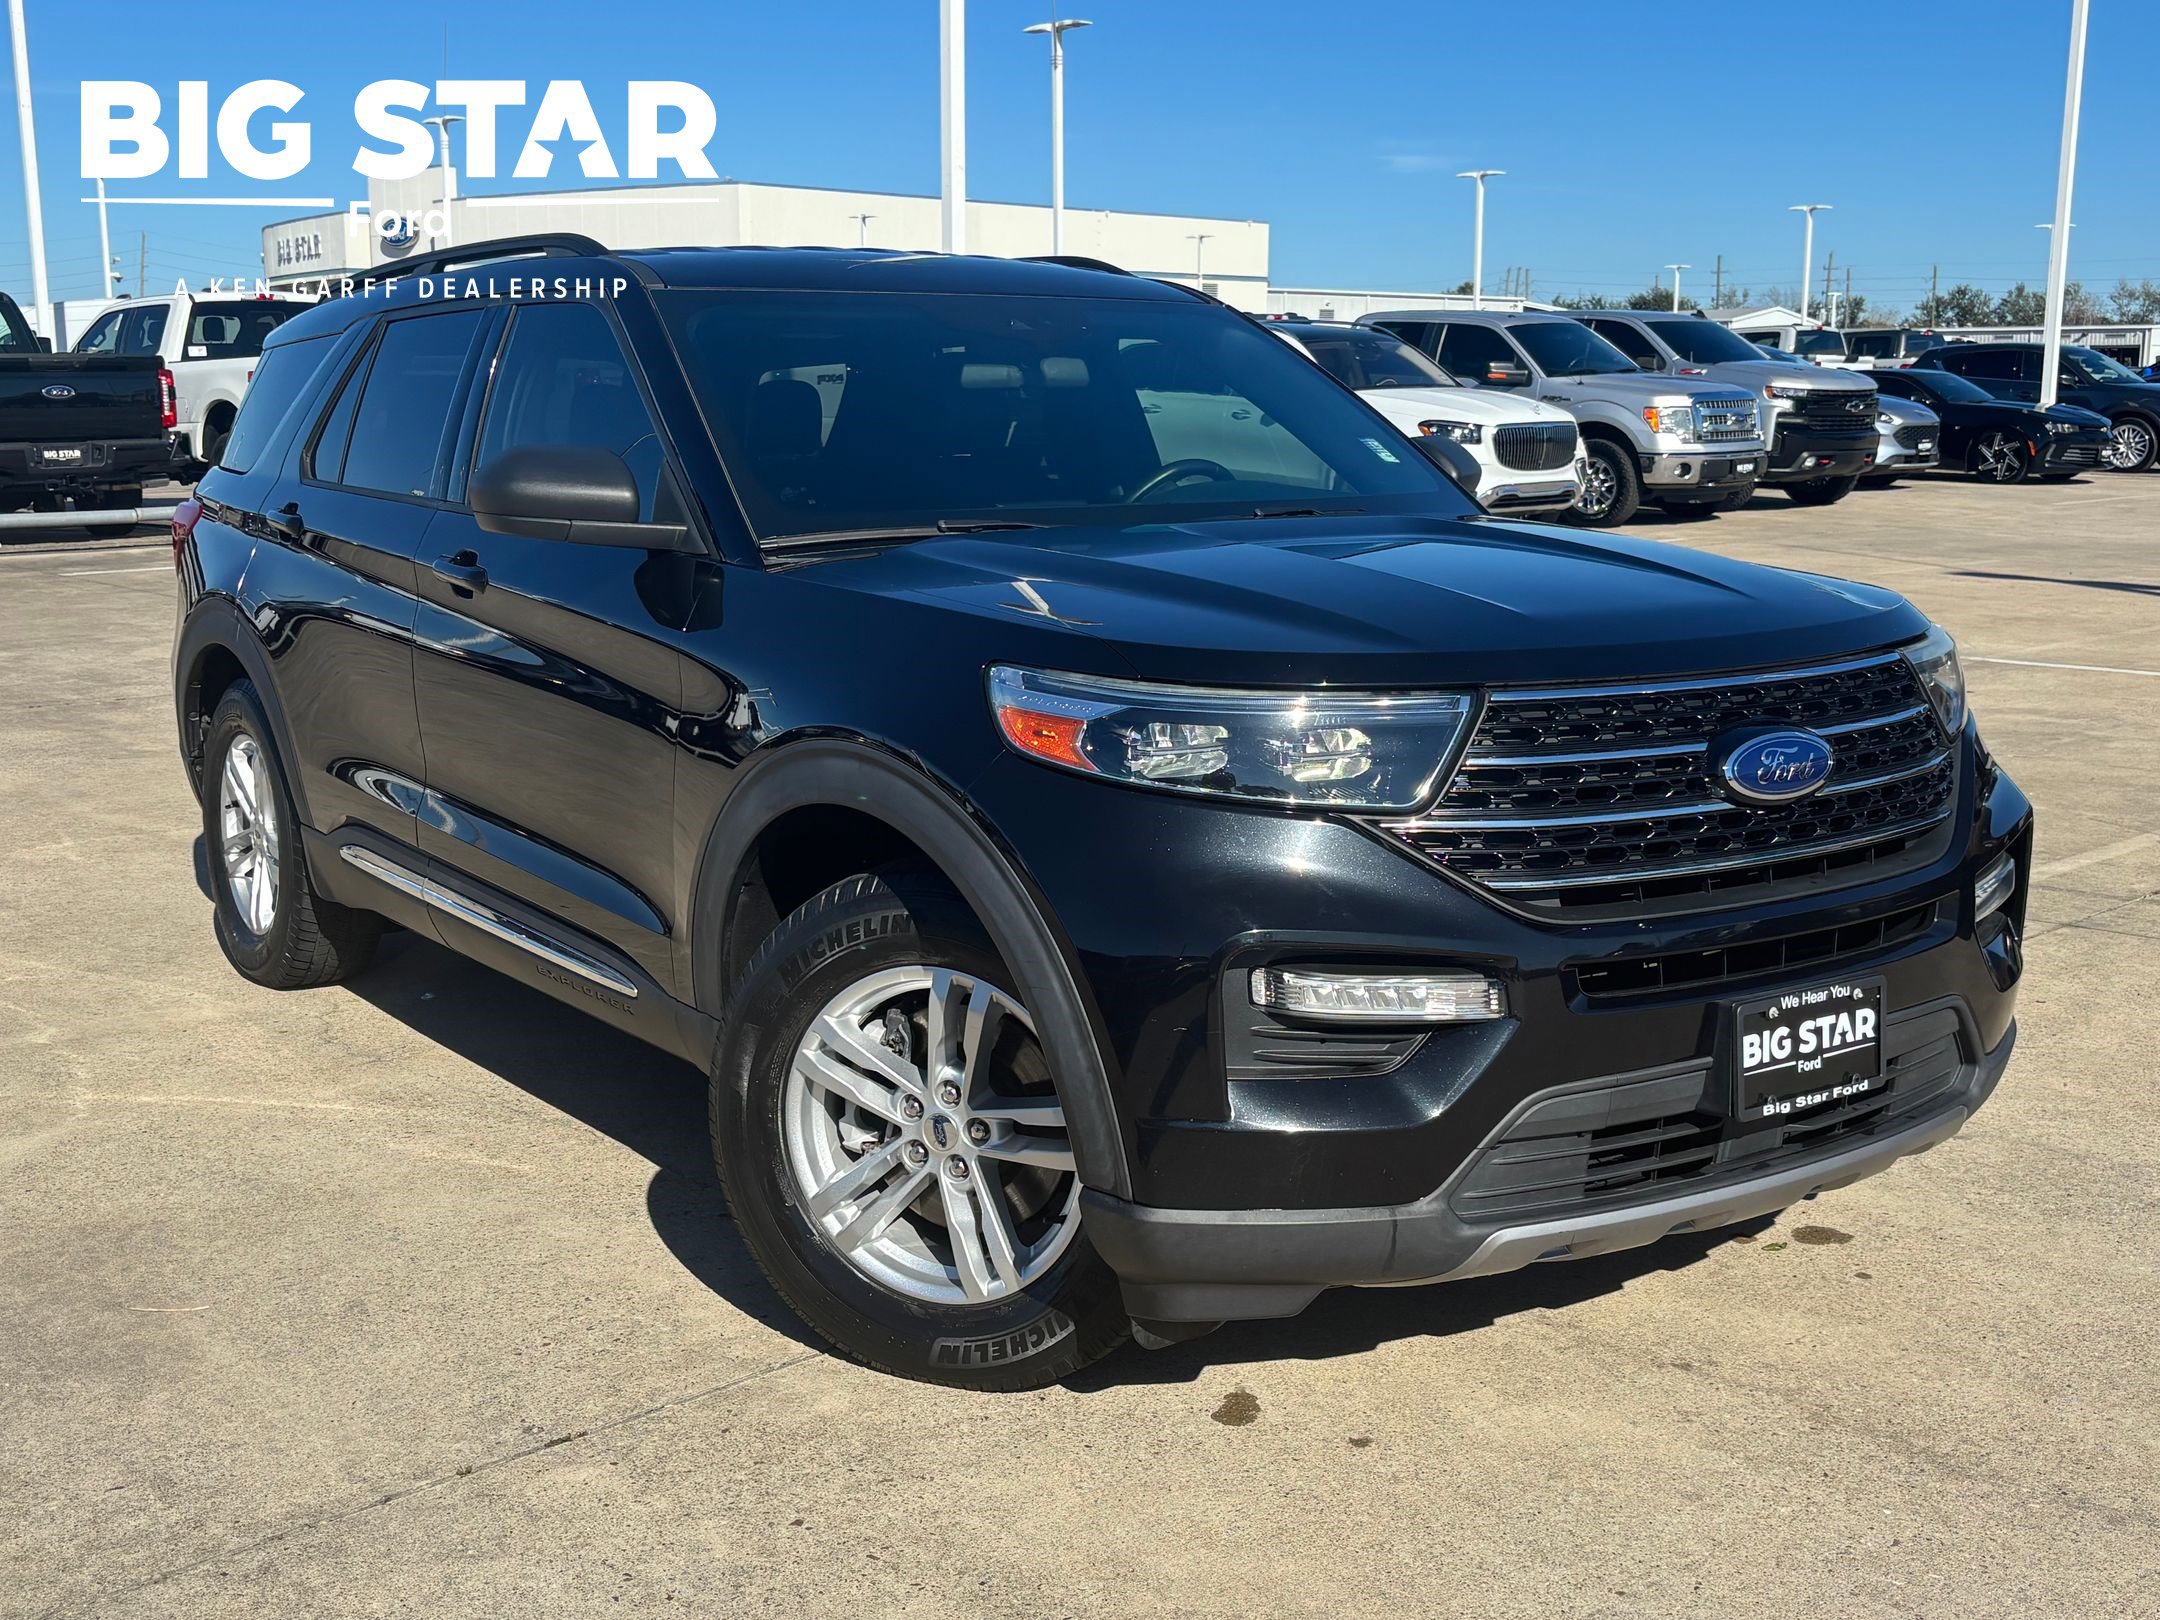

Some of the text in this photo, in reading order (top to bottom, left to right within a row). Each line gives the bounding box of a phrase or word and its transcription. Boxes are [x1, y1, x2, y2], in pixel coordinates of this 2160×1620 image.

[1757, 746, 1816, 785] Ford
[778, 913, 912, 986] MICHELIN
[536, 964, 635, 1016] EXPLORER
[1780, 984, 1850, 1010] We Hear You
[1742, 1008, 1876, 1069] BIG STAR
[1797, 1055, 1822, 1073] Ford
[1762, 1079, 1869, 1116] Big Star Ford
